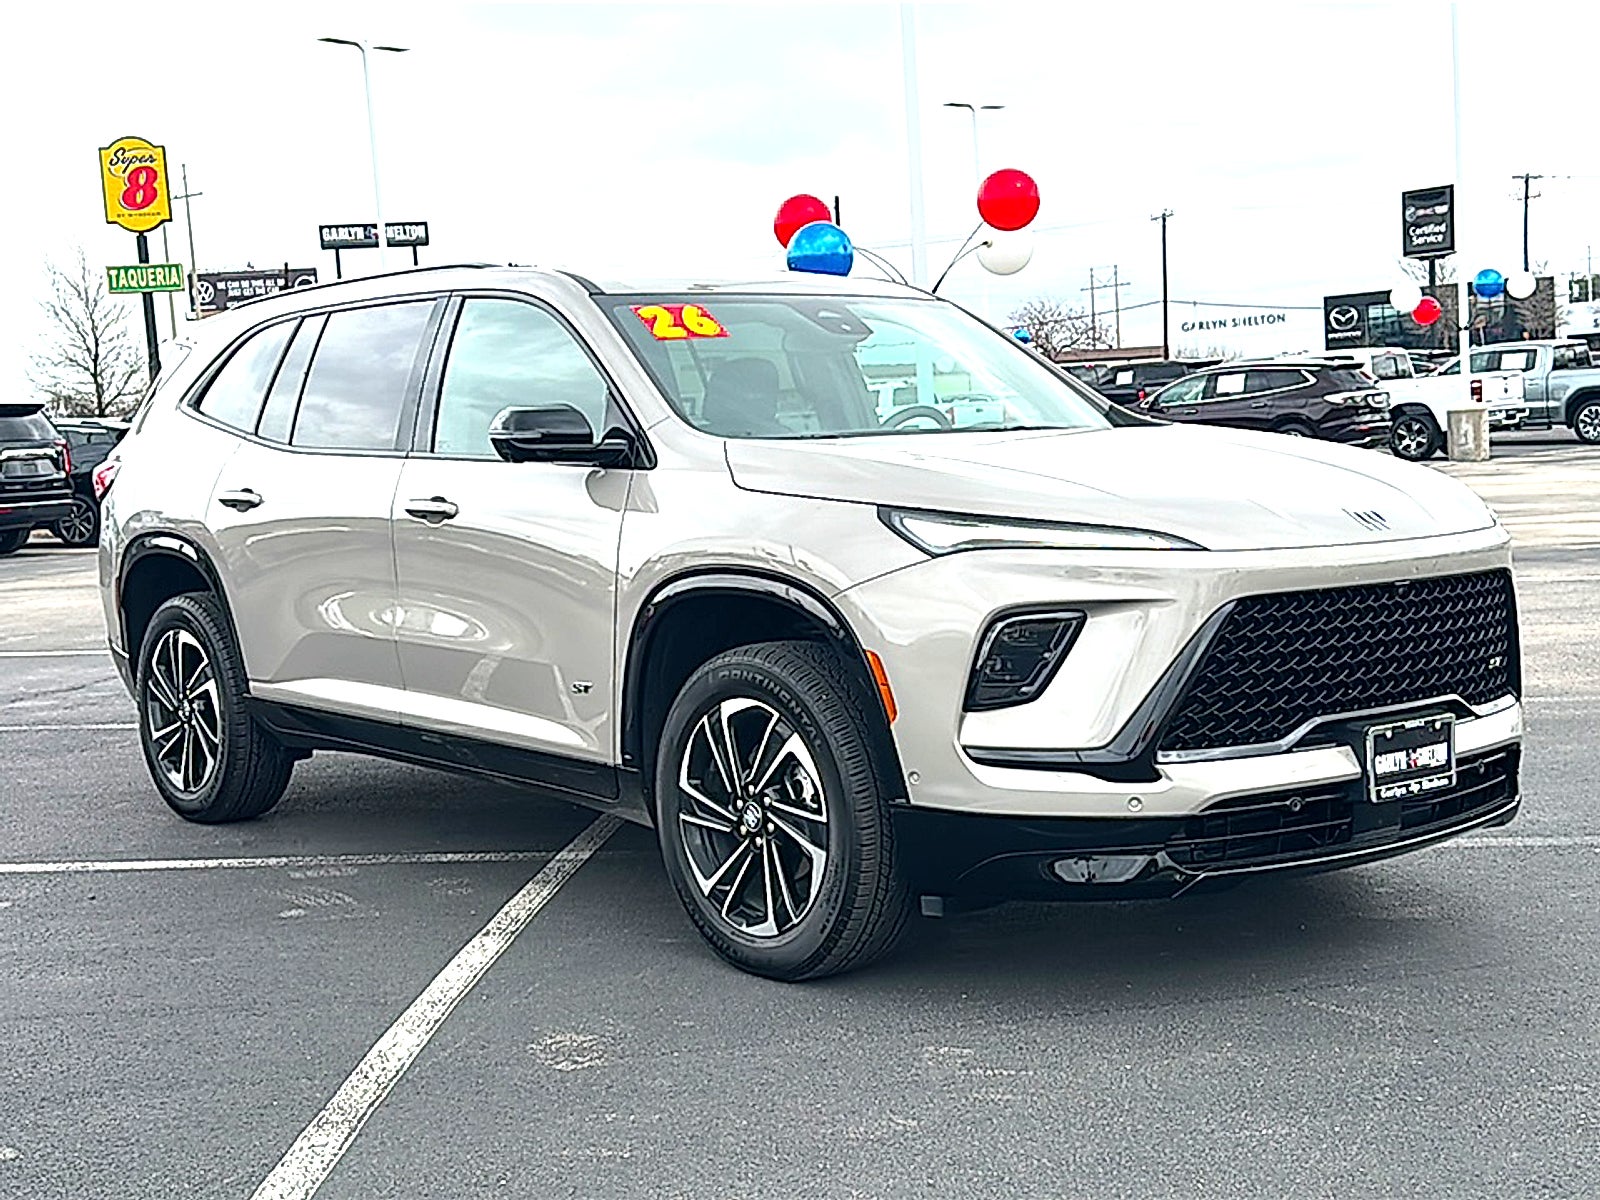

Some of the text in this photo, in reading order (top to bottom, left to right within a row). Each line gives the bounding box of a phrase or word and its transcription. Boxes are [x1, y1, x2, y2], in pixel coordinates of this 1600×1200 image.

[109, 147, 157, 174] Super
[119, 166, 158, 210] 8
[108, 266, 180, 288] TAQUERIA
[636, 304, 721, 338] 26
[571, 681, 593, 694] ST
[718, 669, 822, 752] CONTINENTAL
